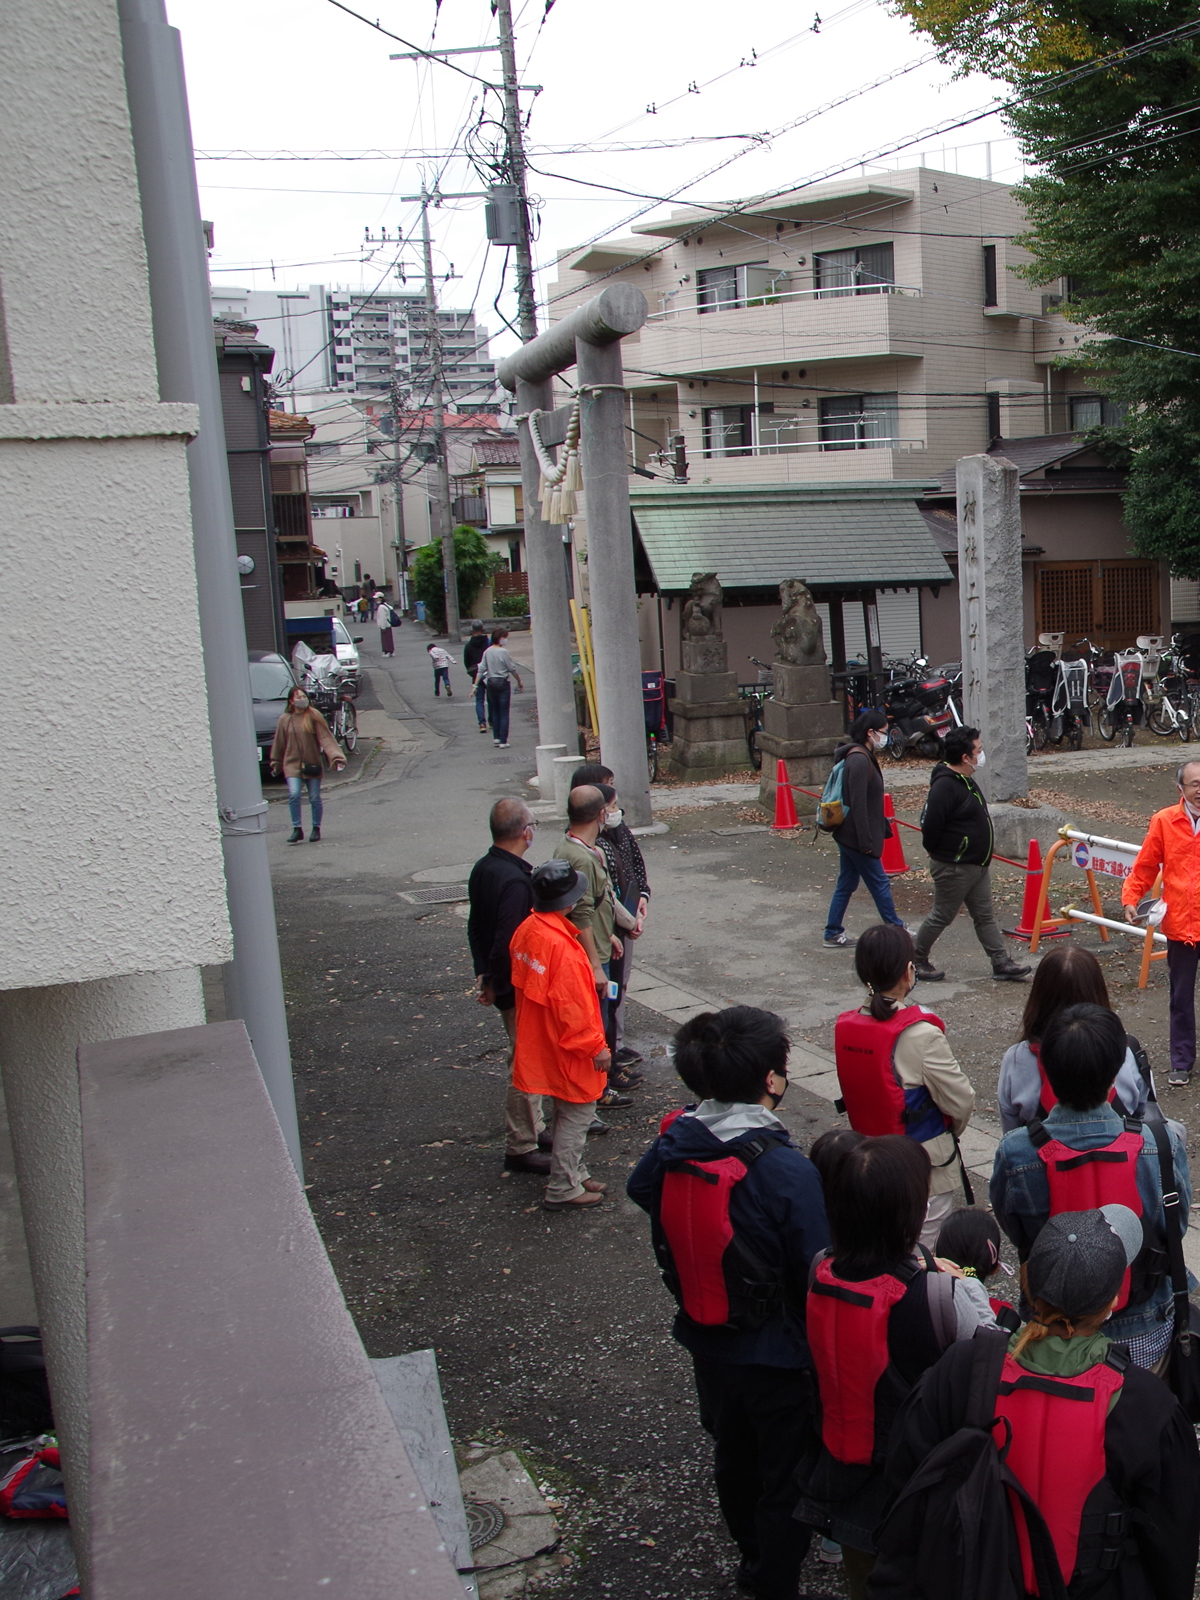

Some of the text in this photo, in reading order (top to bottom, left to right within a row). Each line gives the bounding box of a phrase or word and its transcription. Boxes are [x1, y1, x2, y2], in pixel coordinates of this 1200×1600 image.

[962, 491, 981, 733] 村社二子神
